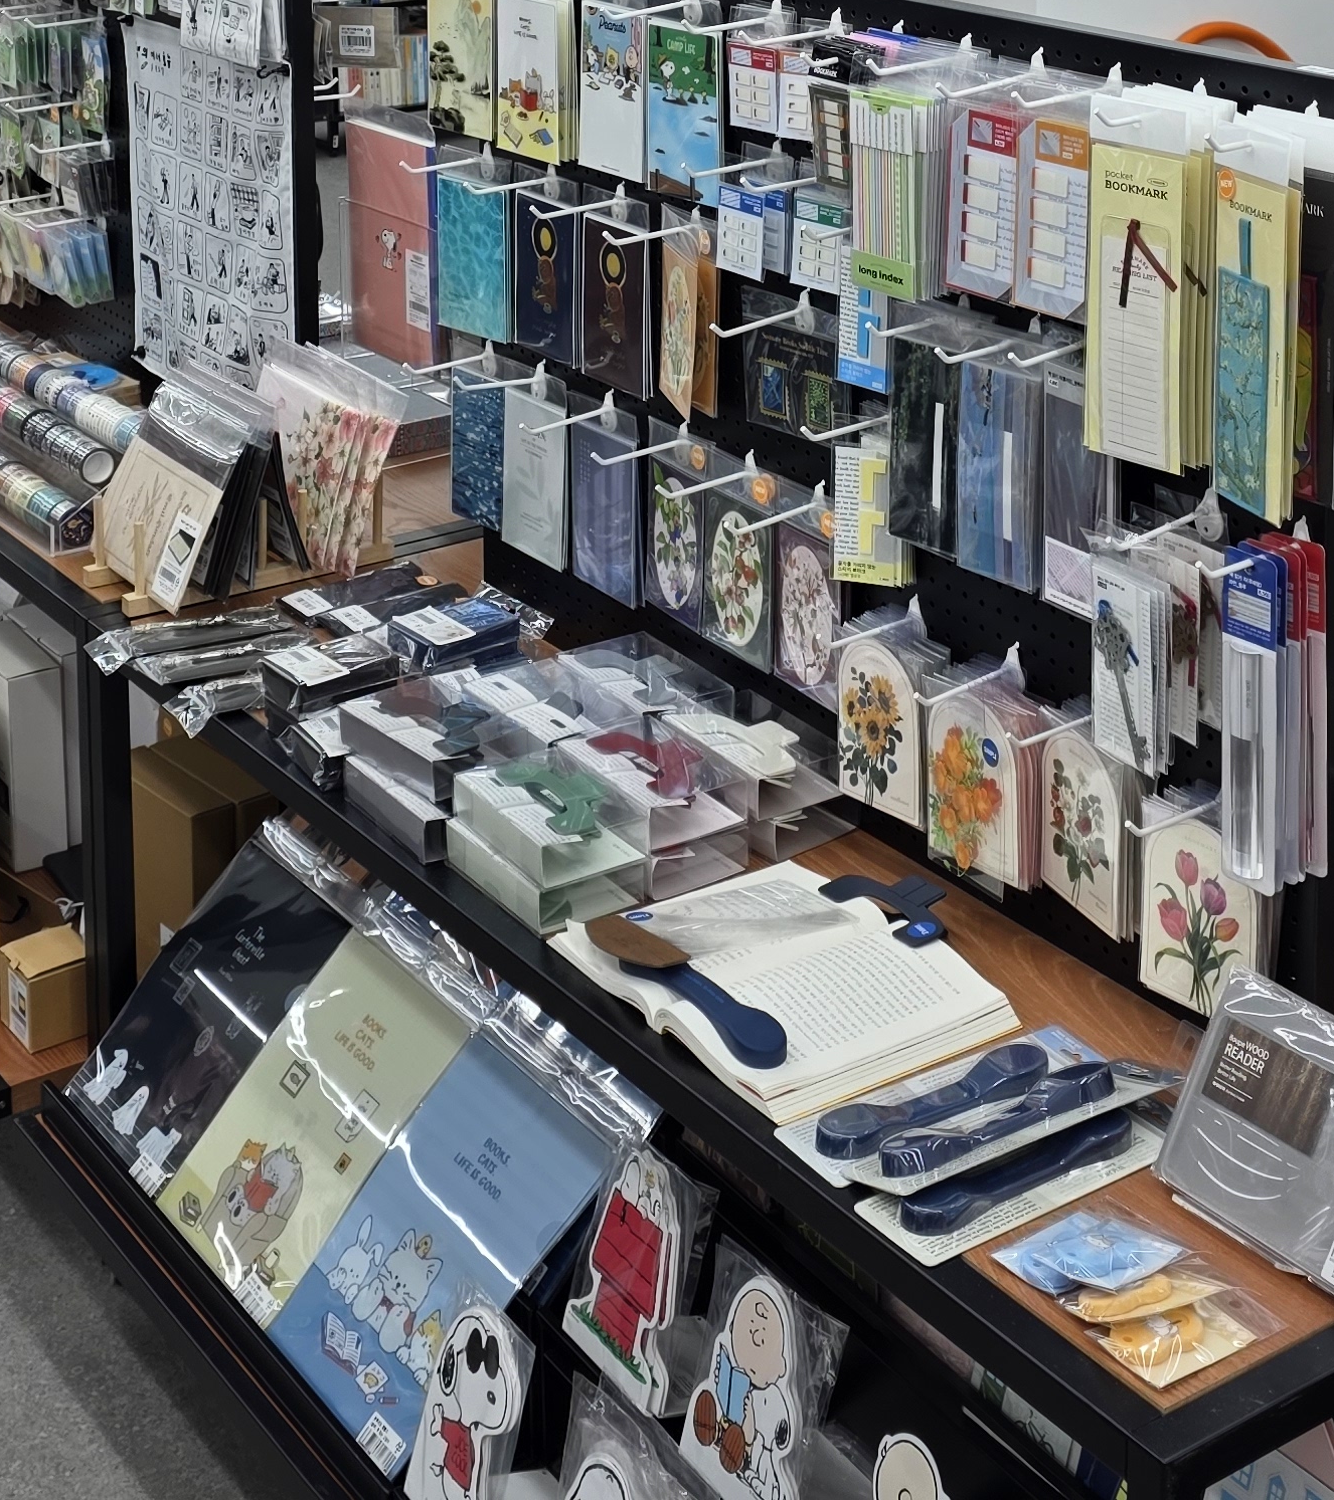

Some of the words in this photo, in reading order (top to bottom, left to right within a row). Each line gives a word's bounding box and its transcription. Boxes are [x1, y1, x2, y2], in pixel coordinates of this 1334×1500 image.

[598, 14, 627, 34] Peanuts
[667, 39, 684, 52] CAMP
[684, 41, 696, 55] LIFE
[1104, 170, 1134, 182] pocket
[1104, 179, 1169, 201] BOOKMARK
[1229, 199, 1273, 223] BOOKMARK
[858, 263, 878, 280] long
[1142, 271, 1158, 283] LIST
[334, 1030, 351, 1048] LIFE
[1224, 1042, 1266, 1075] READER
[1245, 1040, 1270, 1061] WOOD
[453, 1151, 475, 1175] LIFE
[469, 1167, 482, 1182] IS
[477, 1152, 498, 1178] CATS.
